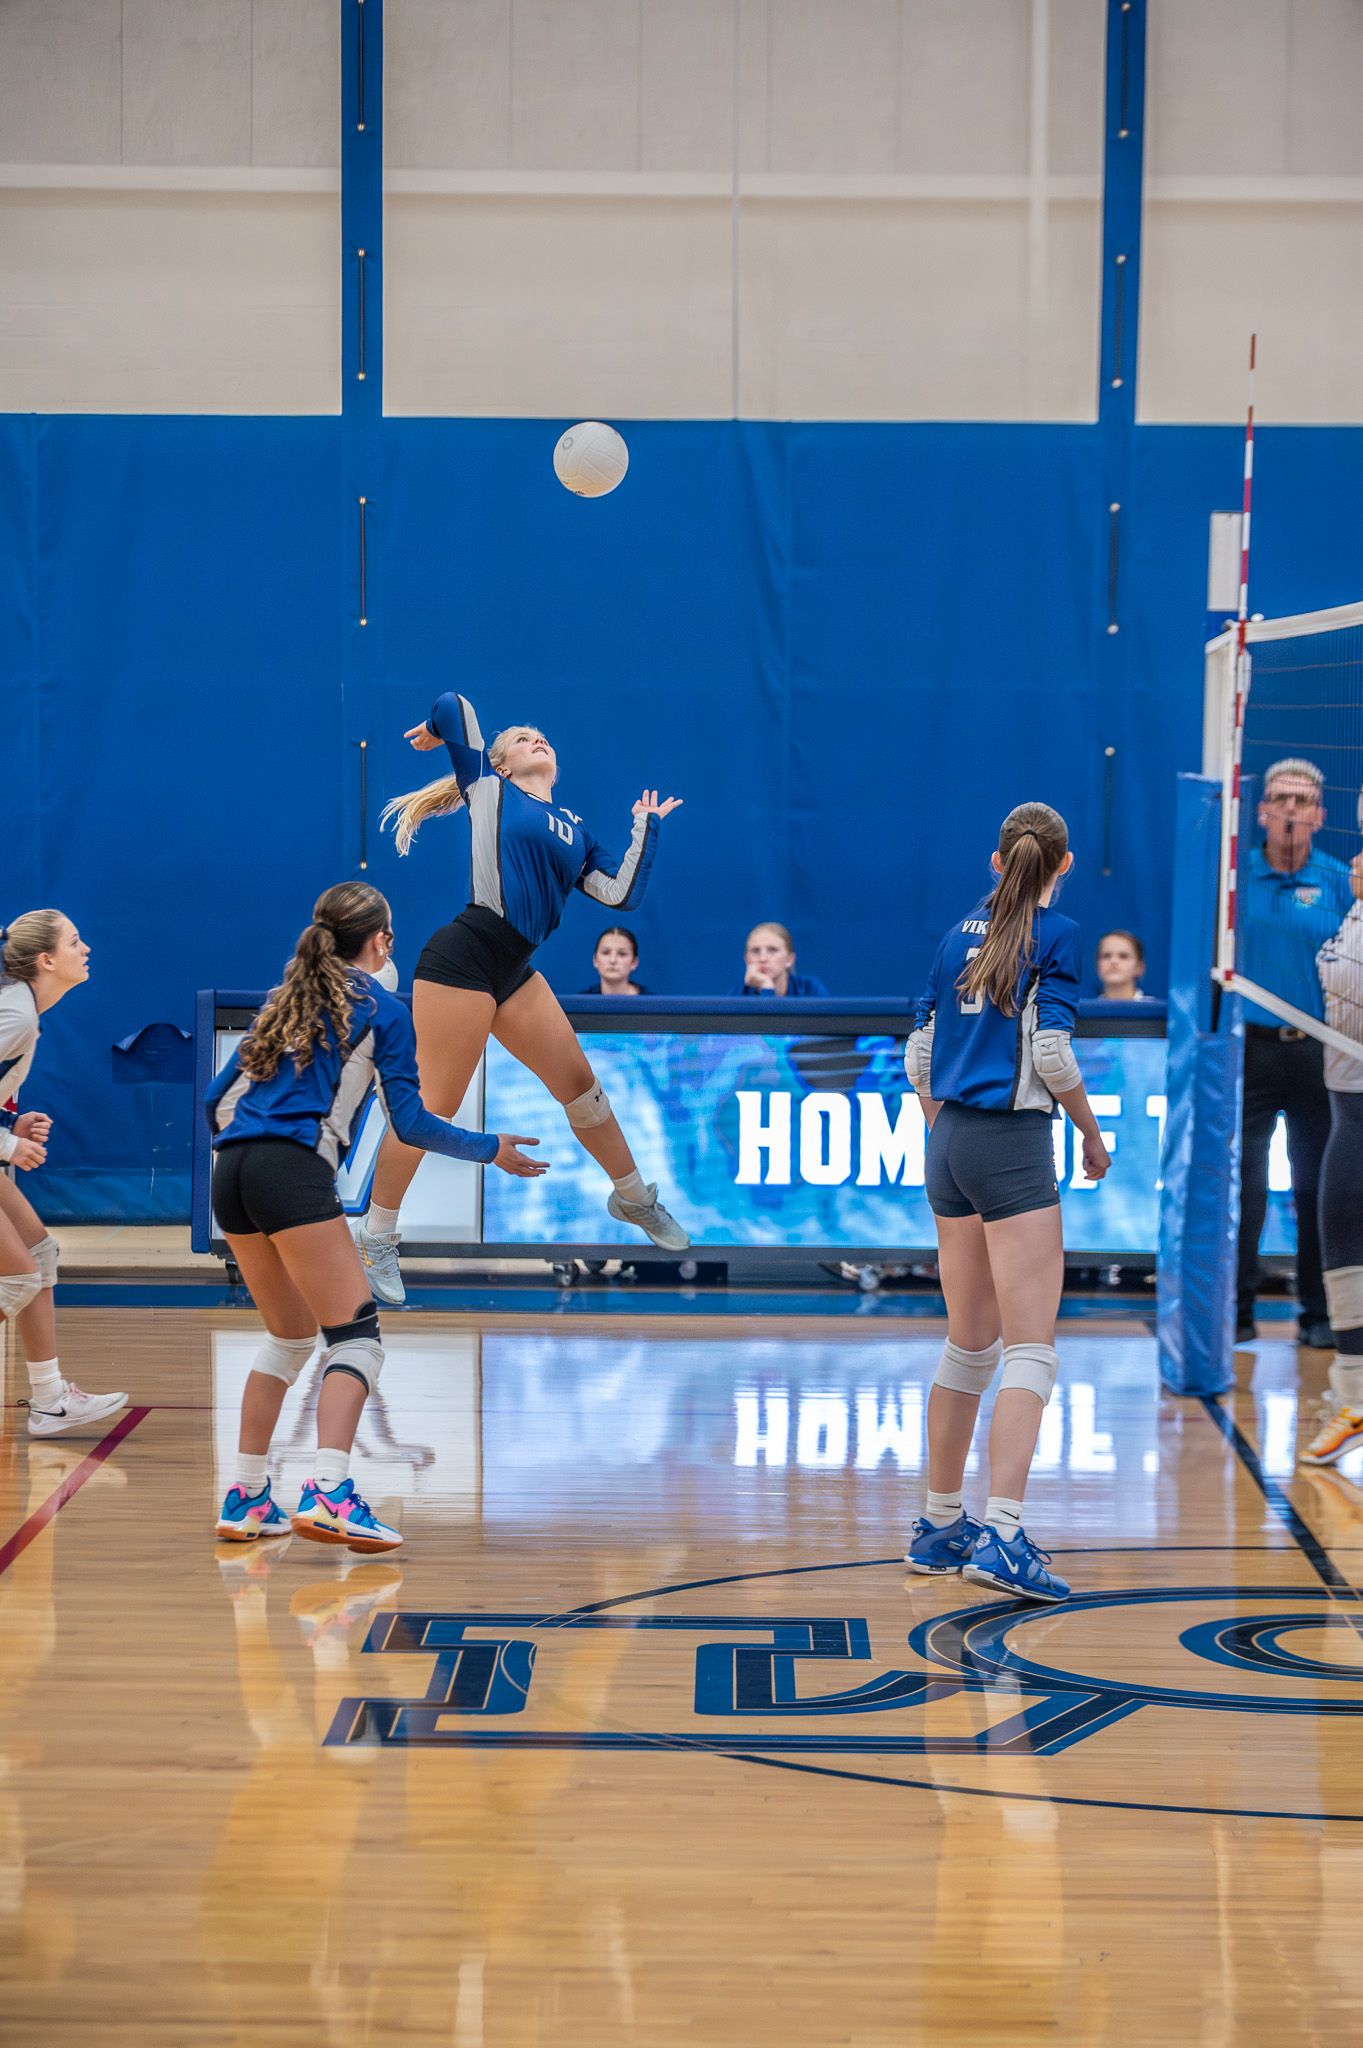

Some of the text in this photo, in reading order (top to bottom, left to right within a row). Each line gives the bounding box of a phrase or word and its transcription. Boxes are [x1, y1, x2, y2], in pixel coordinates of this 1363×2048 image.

[545, 811, 574, 846] 10
[961, 919, 991, 935] VIK
[735, 1091, 926, 1187] HOM
